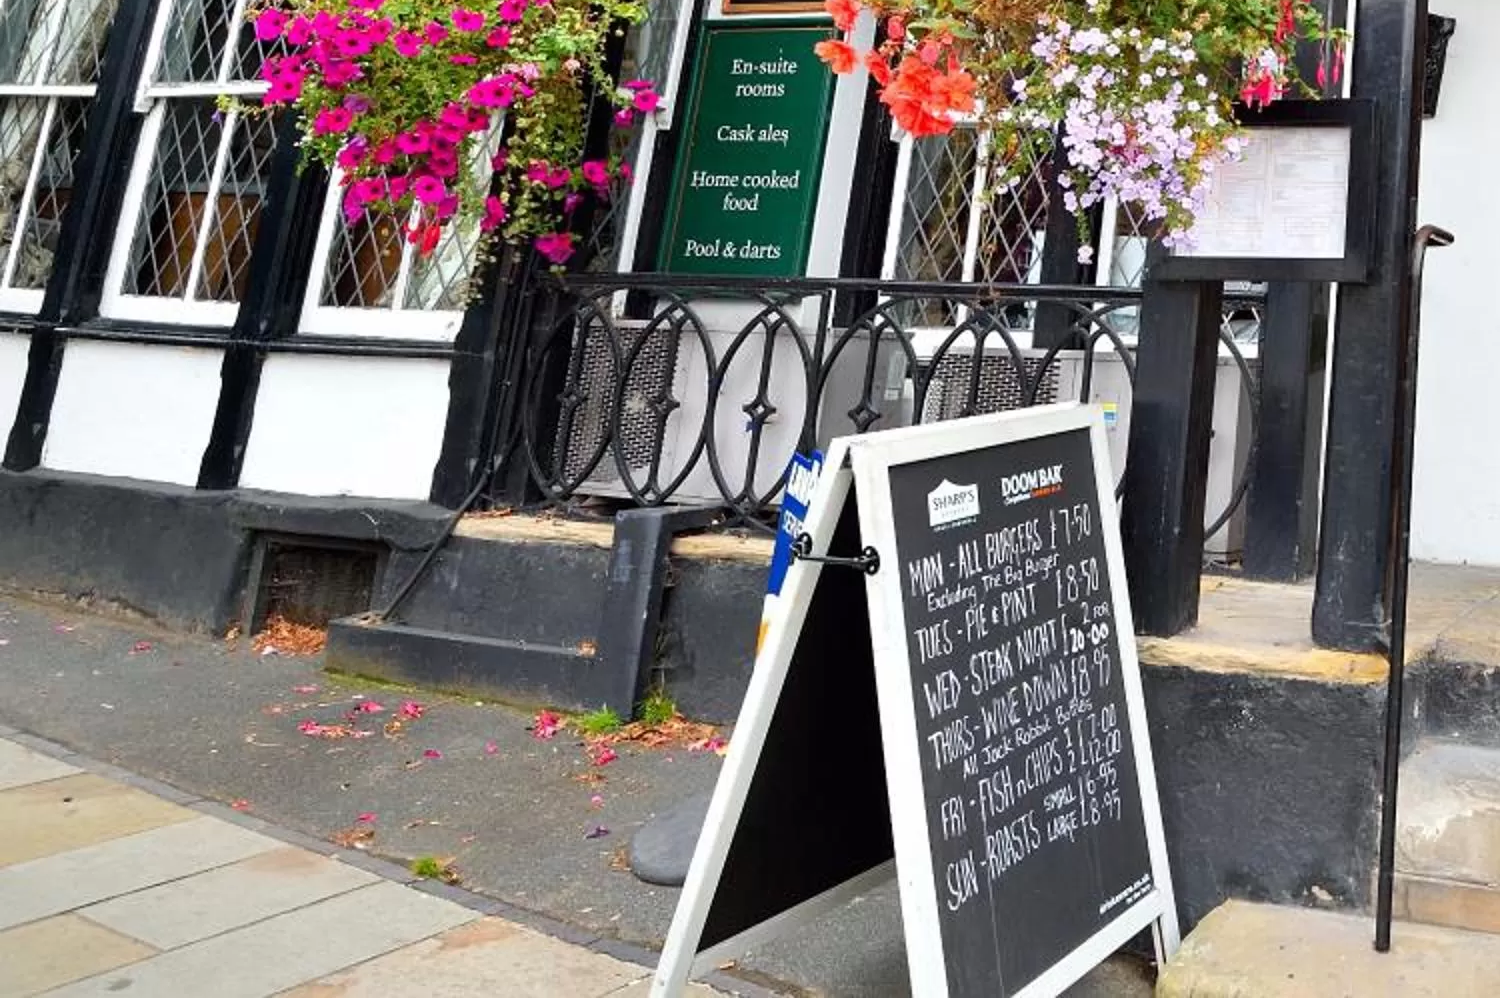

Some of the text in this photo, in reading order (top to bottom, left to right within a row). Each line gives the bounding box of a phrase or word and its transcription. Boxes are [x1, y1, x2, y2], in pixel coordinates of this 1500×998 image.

[730, 55, 798, 75] En-suite
[735, 82, 785, 97] rooms
[717, 123, 789, 143] Cask ales
[690, 169, 800, 188] Home cooked
[722, 191, 759, 211] food
[684, 238, 781, 259] Pool & darts
[1001, 470, 1038, 497] DOOM
[1038, 464, 1063, 487] BAR
[933, 489, 975, 511] SHARP'S
[908, 552, 944, 597] MON
[958, 539, 983, 579] ALL
[985, 518, 1043, 566] BURGERS
[981, 572, 1002, 592] The
[1025, 553, 1060, 580] Burger
[914, 619, 953, 664] TUES
[965, 603, 989, 643] PIE
[1001, 583, 1037, 627] PINT
[1081, 601, 1111, 625] 2 FOR
[923, 669, 962, 719] WED
[969, 642, 1015, 696] STEAK
[1016, 619, 1057, 670] NIGHT
[928, 715, 975, 771] THURS
[981, 686, 1021, 741] WINE
[1023, 659, 1068, 717] DOWN
[983, 735, 1015, 766] Jack
[1068, 749, 1077, 774] 2
[940, 795, 966, 840] FRI
[978, 765, 1015, 820] FISH
[1025, 737, 1063, 789] CHIPS
[947, 850, 979, 911] SUN
[985, 809, 1041, 881] ROASTS
